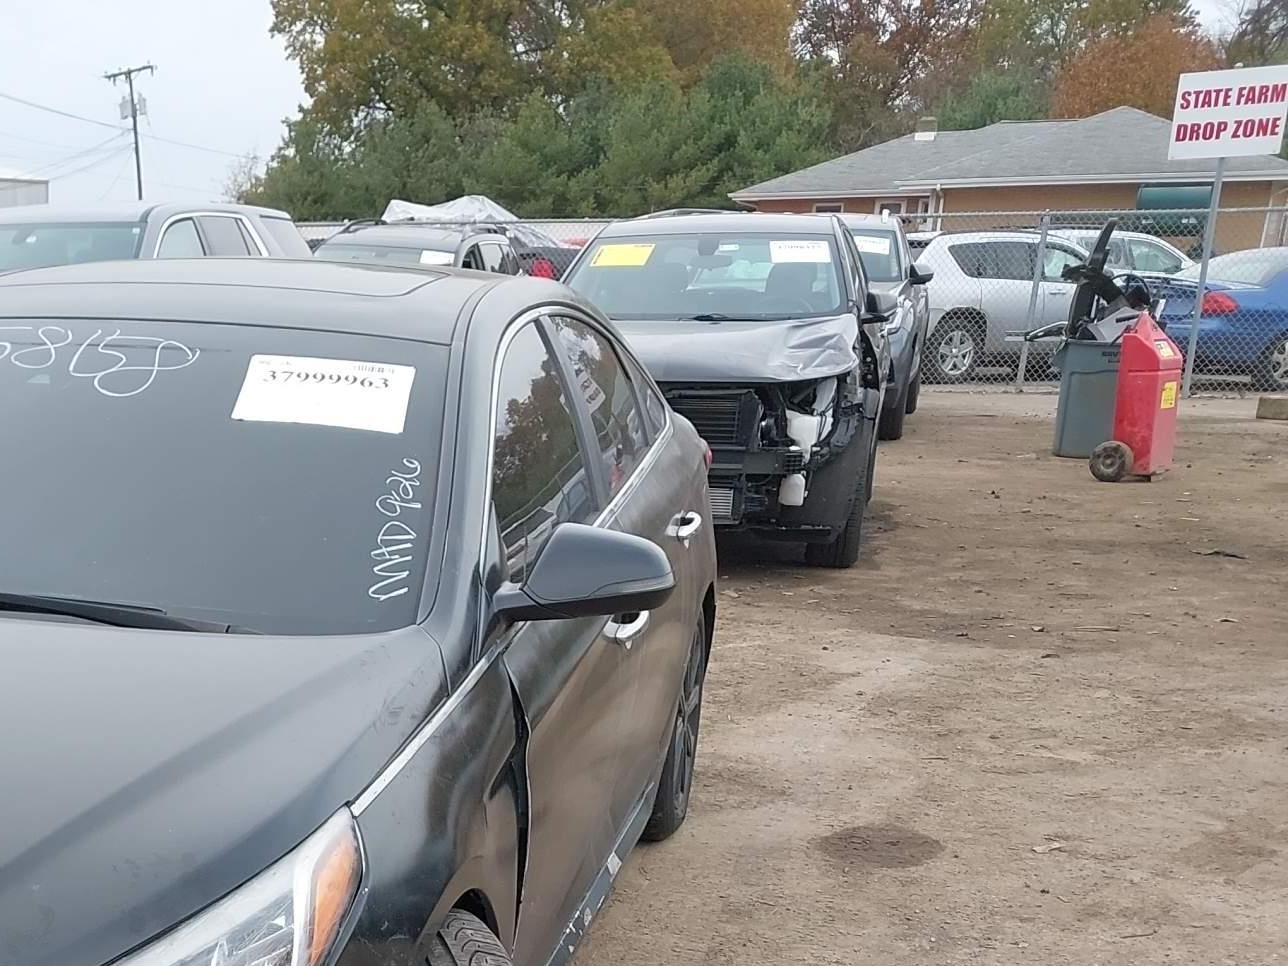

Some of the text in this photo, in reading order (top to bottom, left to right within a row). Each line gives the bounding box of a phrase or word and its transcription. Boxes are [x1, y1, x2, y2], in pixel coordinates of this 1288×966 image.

[1180, 83, 1288, 110] STATE FARM
[1175, 117, 1281, 142] DROP ZONE
[263, 370, 390, 389] 37999963
